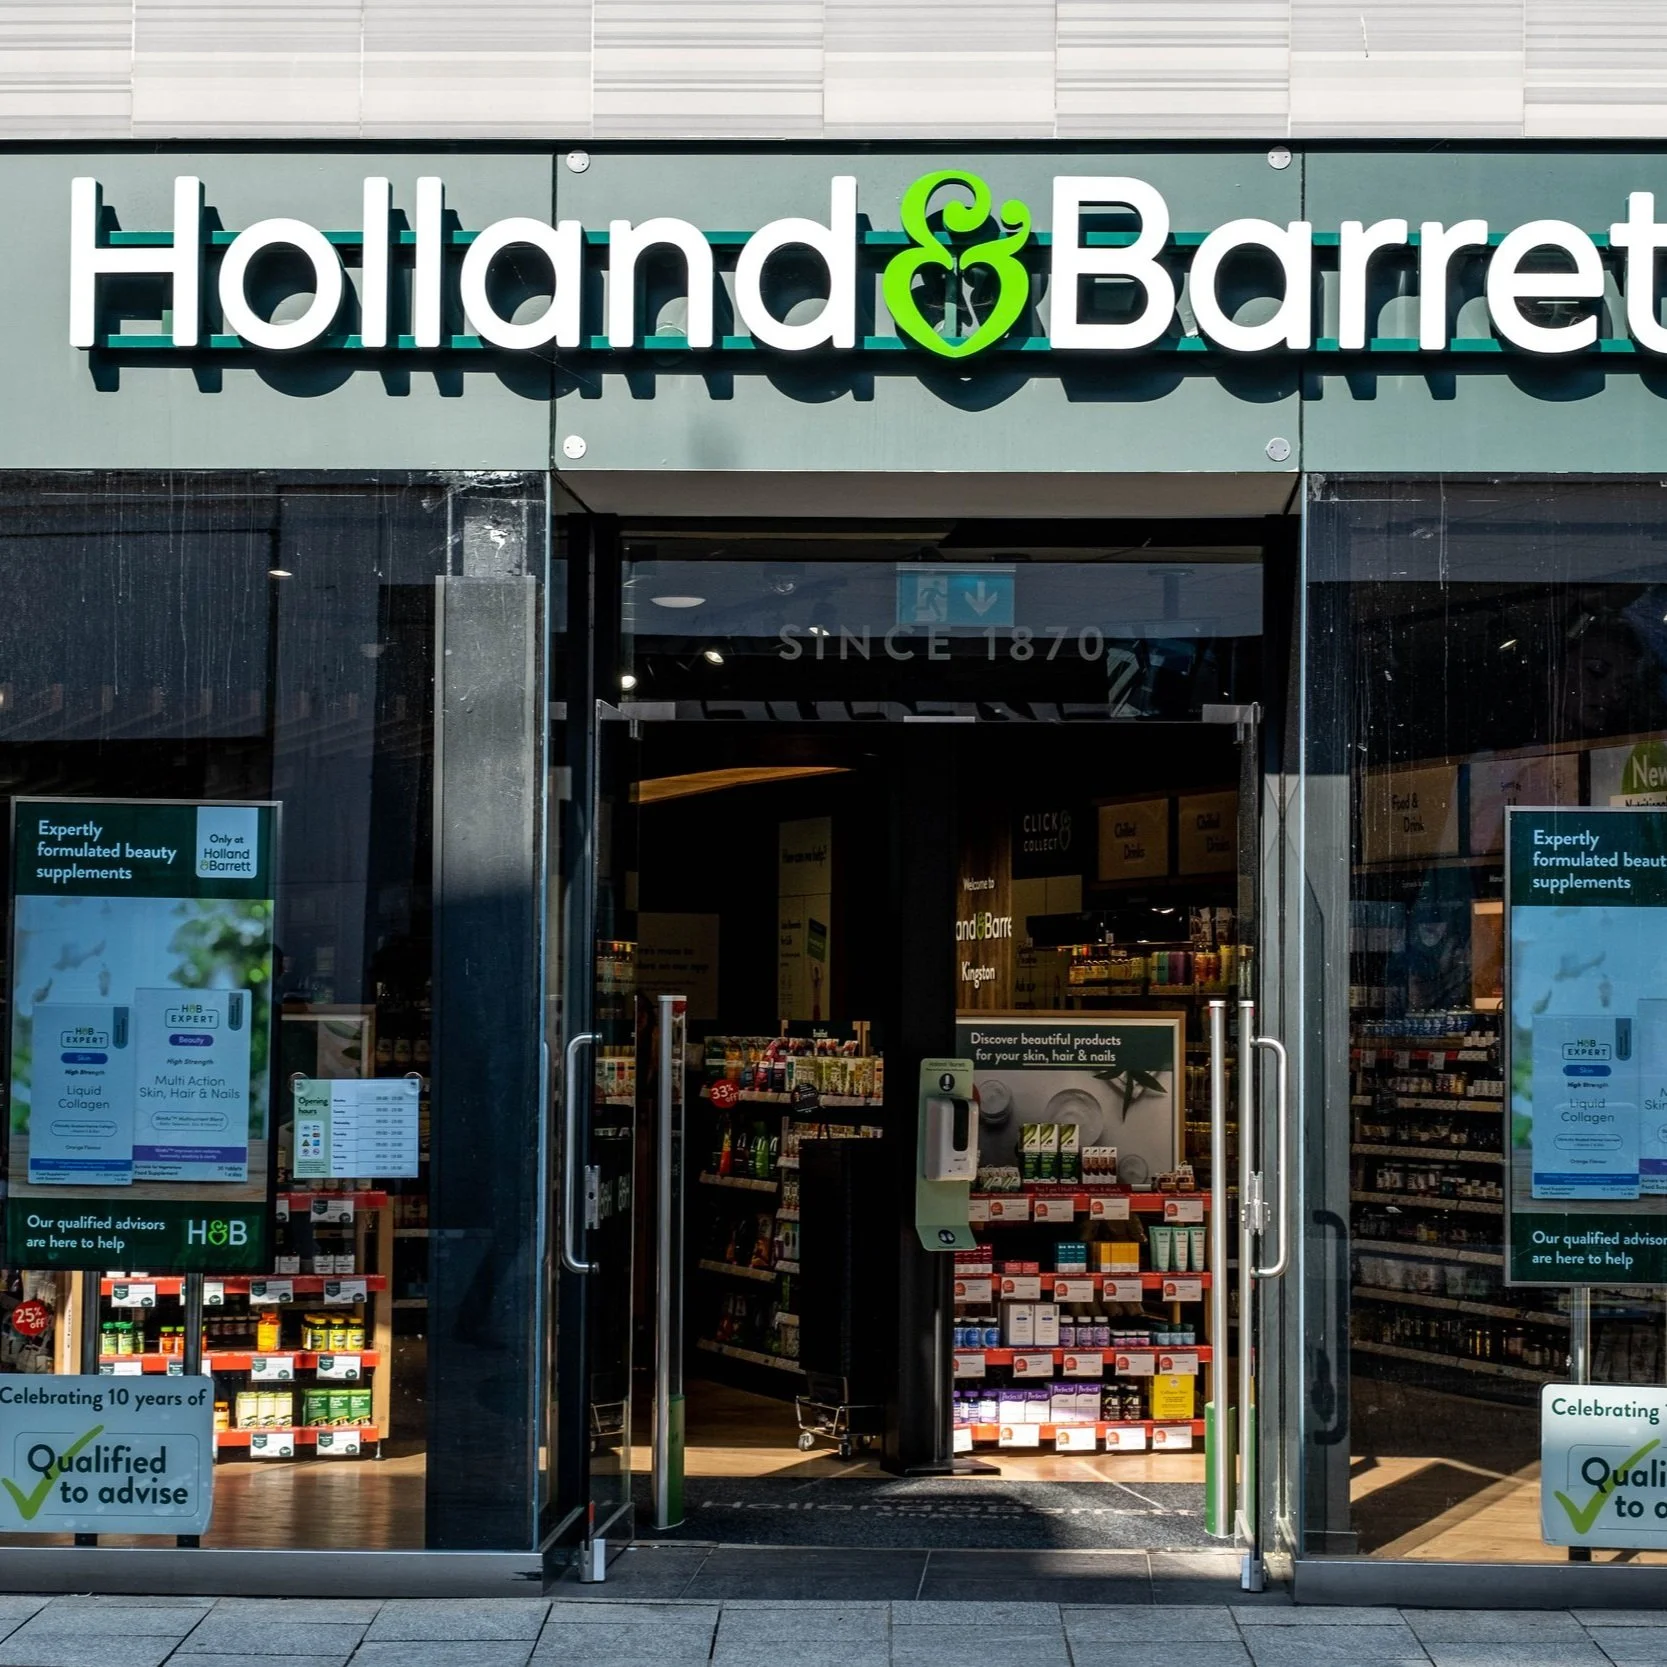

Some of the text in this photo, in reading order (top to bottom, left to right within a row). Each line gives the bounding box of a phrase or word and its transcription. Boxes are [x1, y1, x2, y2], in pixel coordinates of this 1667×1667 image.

[69, 175, 857, 351] Holland
[778, 623, 1105, 661] SINCE 1870
[38, 820, 103, 841] Expertly
[1023, 812, 1057, 833] CLICK
[1403, 817, 1424, 834] Drink
[209, 833, 244, 846] Only at
[1023, 838, 1057, 852] COLLECT
[1533, 829, 1600, 851] Expertly
[37, 841, 177, 864] formulated beauty
[203, 848, 250, 859] Holland
[1532, 851, 1618, 868] formulated
[36, 864, 132, 884] supplements
[209, 860, 251, 872] Barrett
[962, 877, 986, 892] Welcome
[1532, 873, 1631, 894] supplements
[961, 961, 995, 988] Kingston
[170, 1014, 214, 1023] EXPERT
[65, 1036, 104, 1044] EXPERT
[178, 1036, 205, 1045] Beauty
[970, 1032, 1121, 1049] Discover beautiful products
[976, 1046, 1116, 1065] for your skin, hair & nails
[154, 1075, 225, 1087] Multi Action
[67, 1085, 101, 1097] Liquid
[139, 1087, 241, 1099] Skin, Hair & Nails
[58, 1099, 110, 1111] Collagen
[298, 1096, 328, 1106] Opening
[1569, 1098, 1606, 1110] Liquid
[1560, 1111, 1615, 1124] Collagen
[27, 1215, 165, 1232] Our qualified advisors
[188, 1219, 247, 1245] H&B
[26, 1236, 125, 1253] are here to help
[1532, 1231, 1560, 1244] Our
[1563, 1231, 1620, 1248] qualified
[1532, 1251, 1634, 1270] are here to help
[15, 1306, 42, 1324] 25%
[30, 1318, 45, 1328] off
[0, 1387, 207, 1411] Celebrating 10 years of
[1552, 1398, 1660, 1425] Celebrating
[27, 1444, 166, 1479] Qualified
[61, 1476, 188, 1504] to advise
[1615, 1496, 1644, 1518] to
